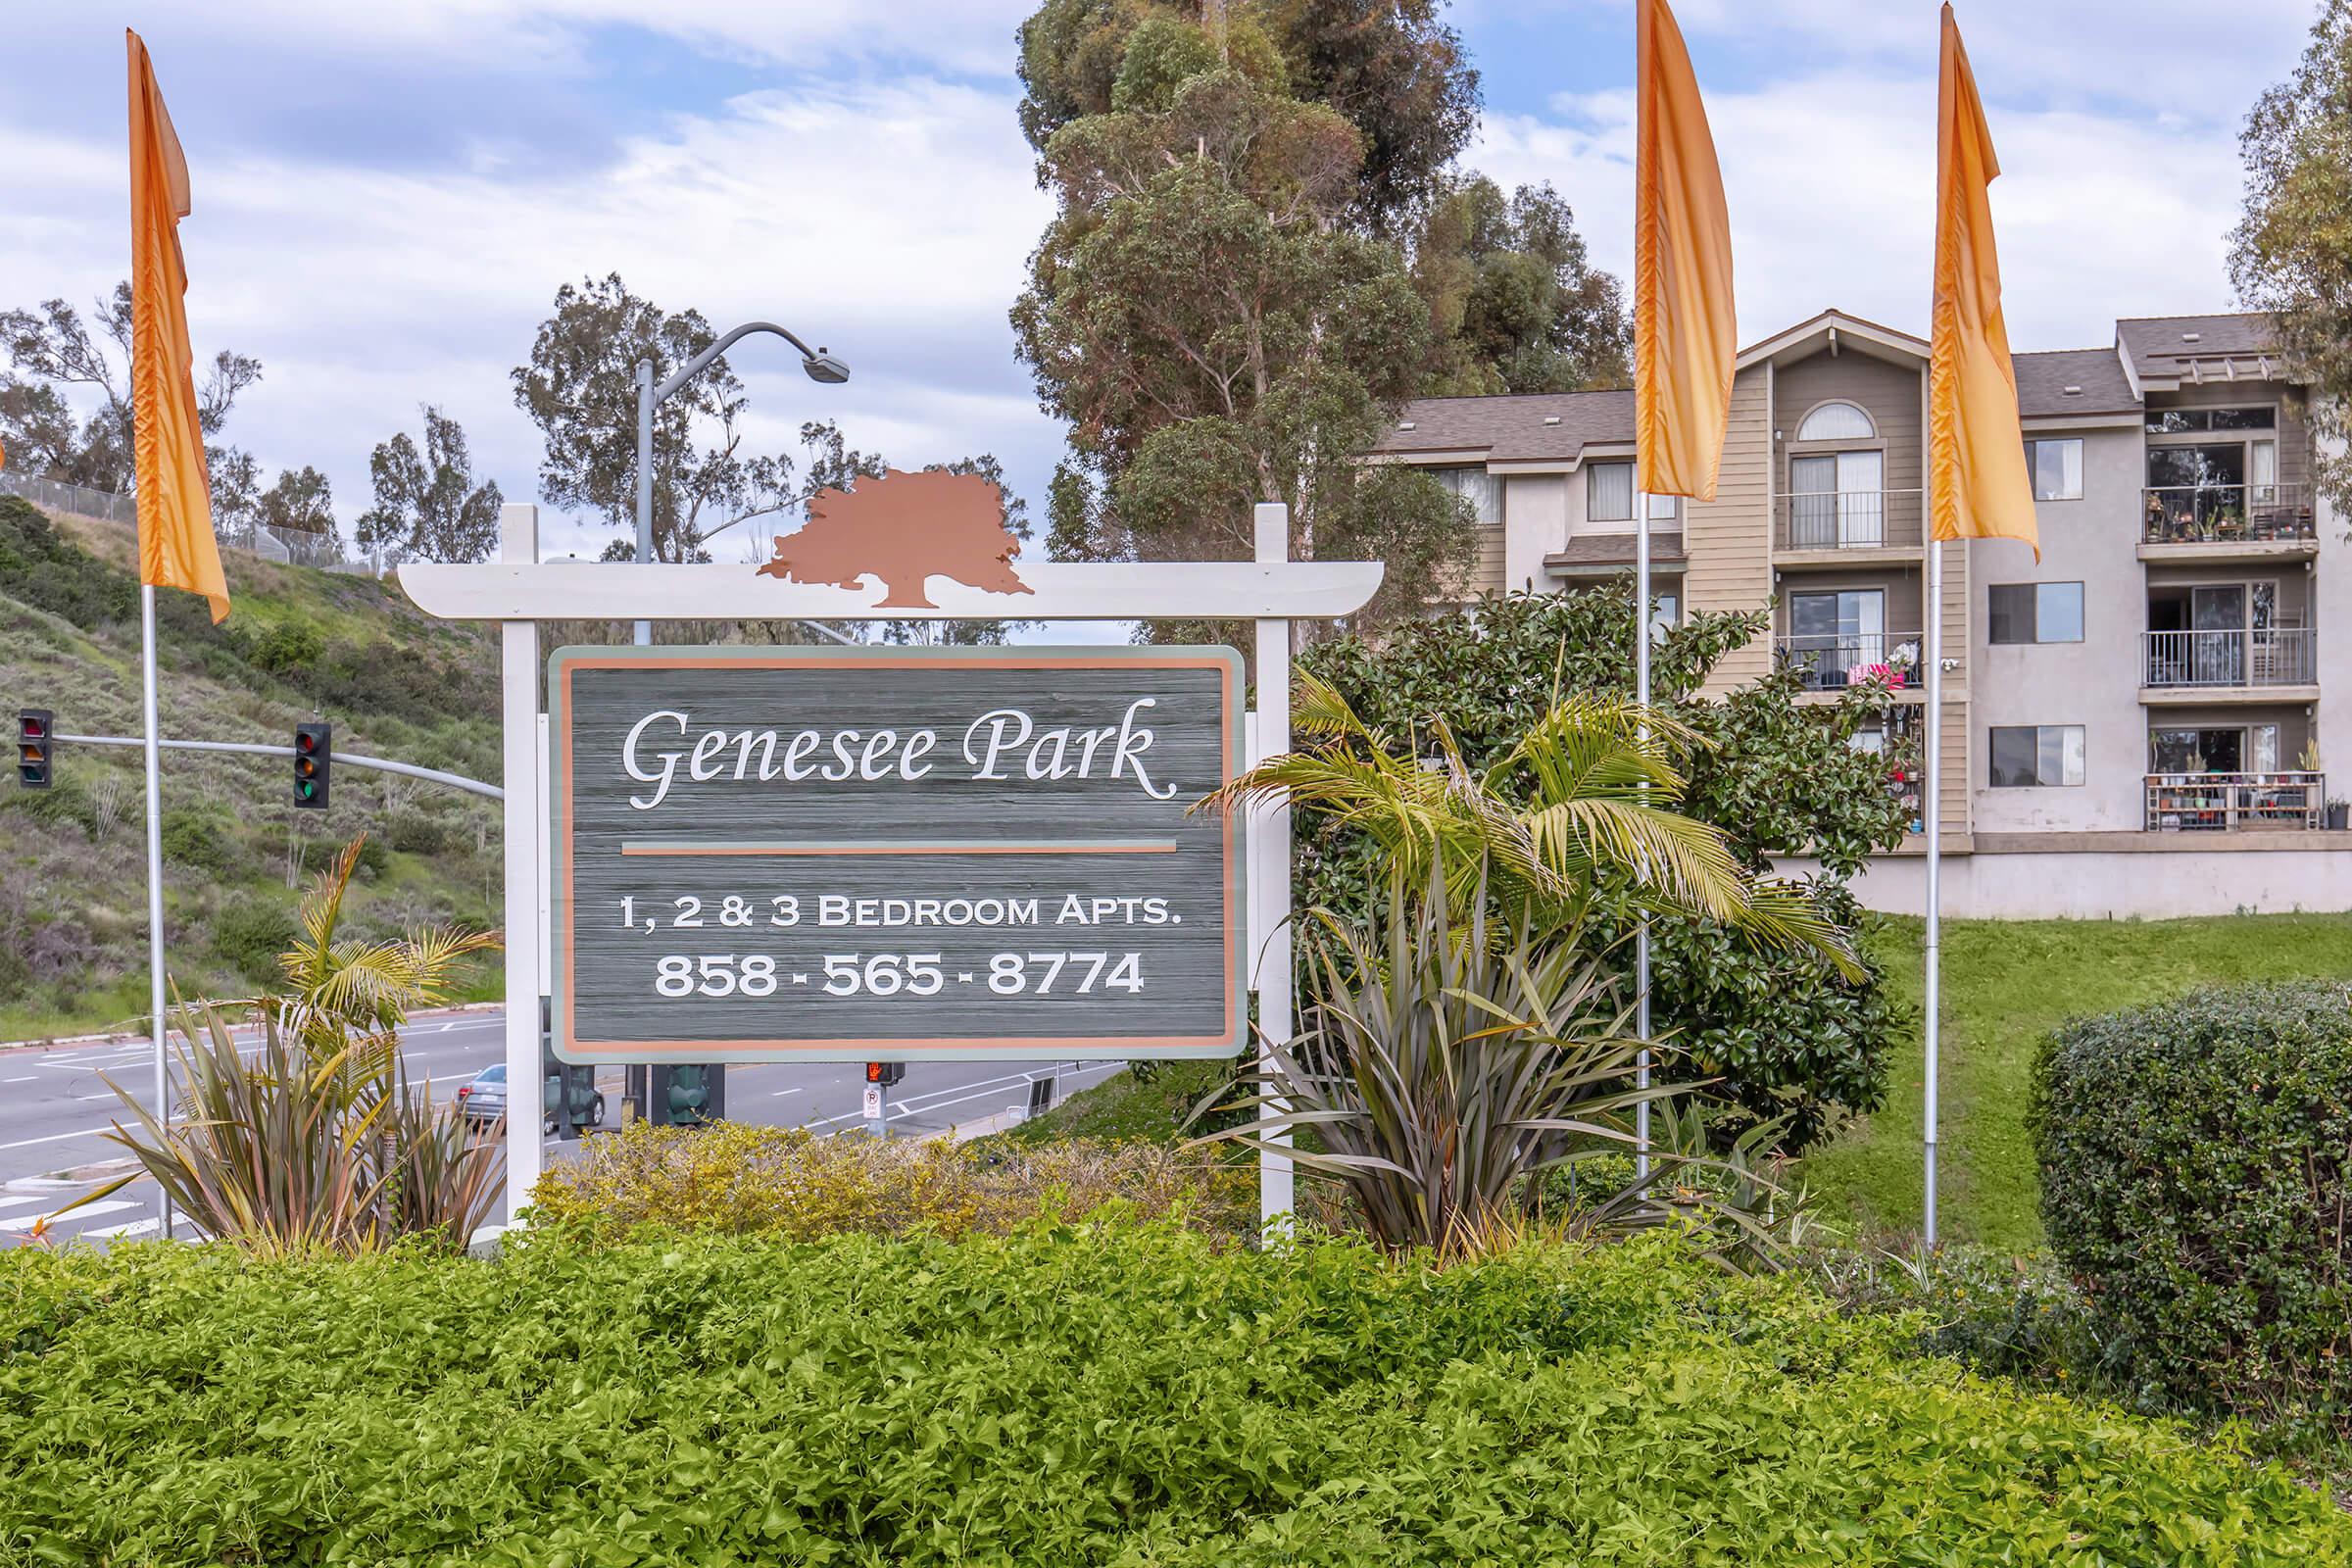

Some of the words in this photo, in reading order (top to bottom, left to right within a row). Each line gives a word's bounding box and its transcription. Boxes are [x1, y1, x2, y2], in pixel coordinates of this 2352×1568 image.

[621, 710, 937, 811] Genesee
[962, 697, 1179, 801] Park
[619, 895, 656, 936] 1,
[673, 895, 705, 928] 2
[719, 894, 754, 928] &
[770, 894, 802, 927] 3
